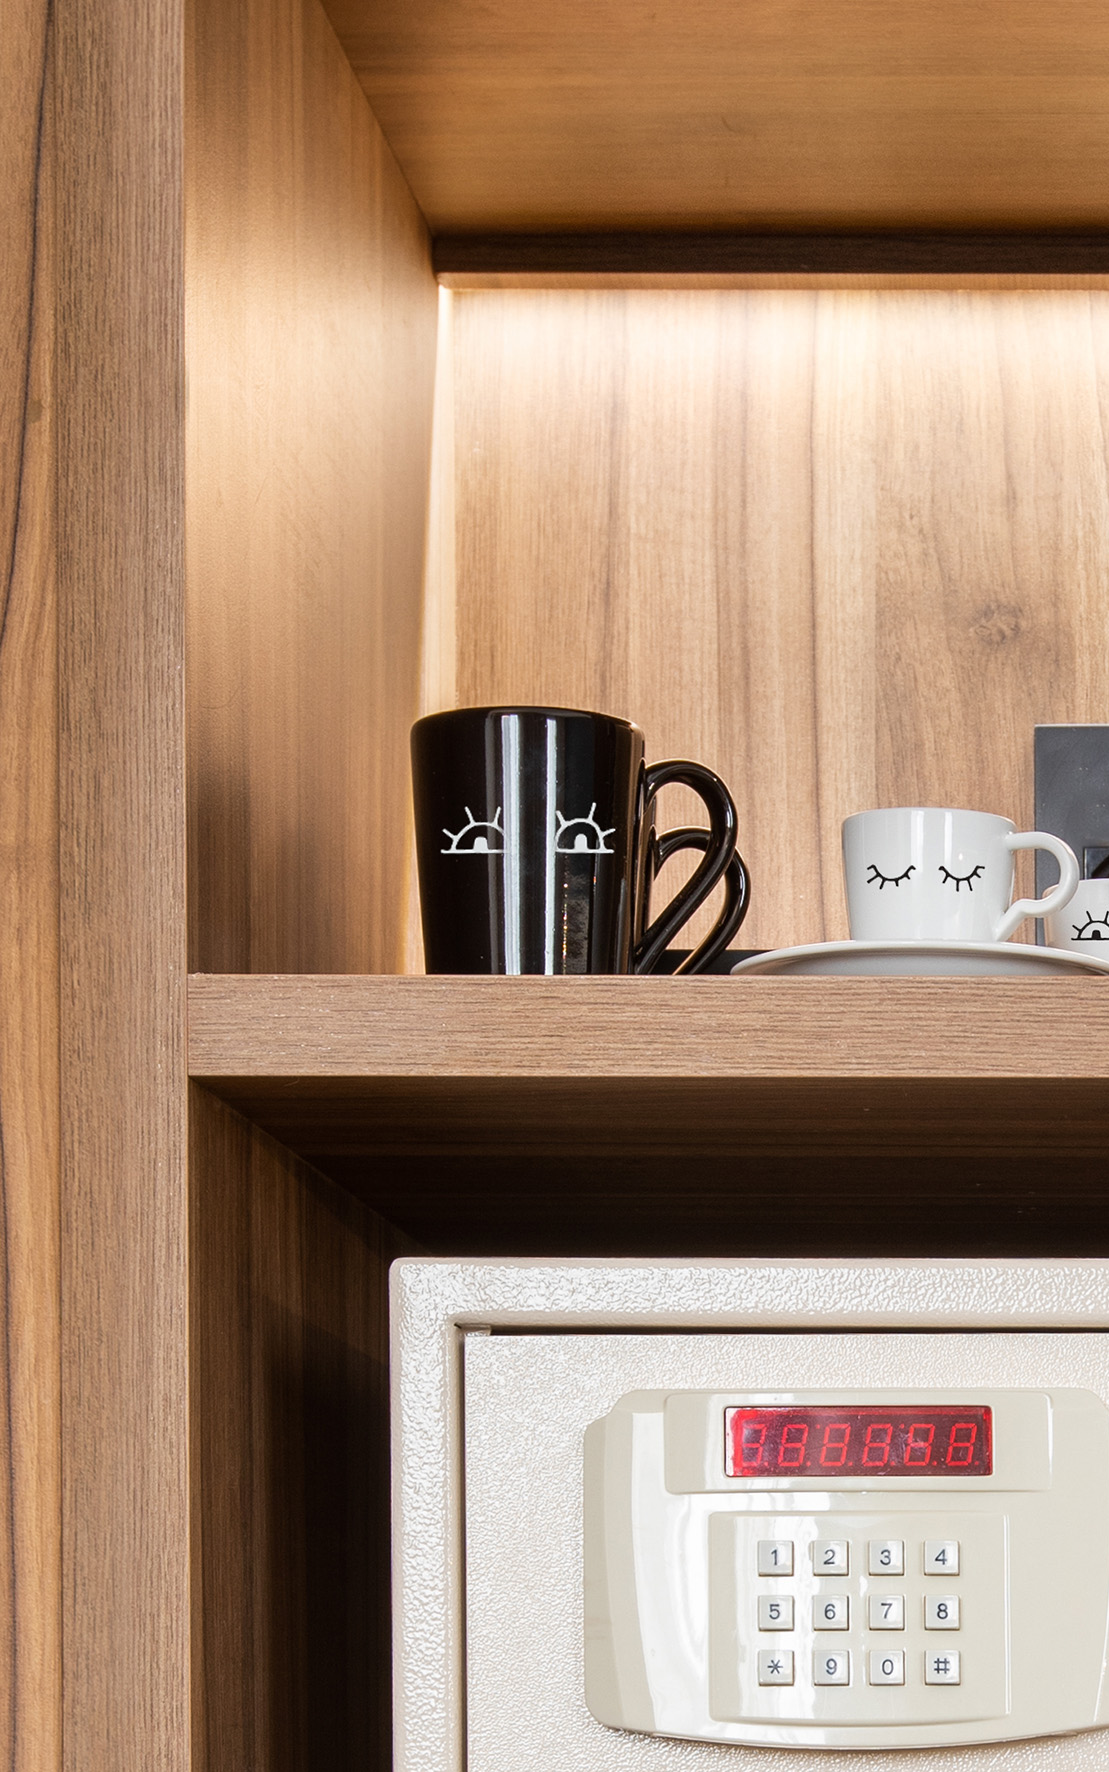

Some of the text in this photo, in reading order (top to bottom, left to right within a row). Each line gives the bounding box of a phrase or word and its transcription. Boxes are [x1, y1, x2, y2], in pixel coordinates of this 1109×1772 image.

[771, 1549, 948, 1566] 1 2 3 4
[769, 1603, 949, 1620] 5 6 7 8
[825, 1658, 838, 1675] 9
[881, 1659, 894, 1676] 0
